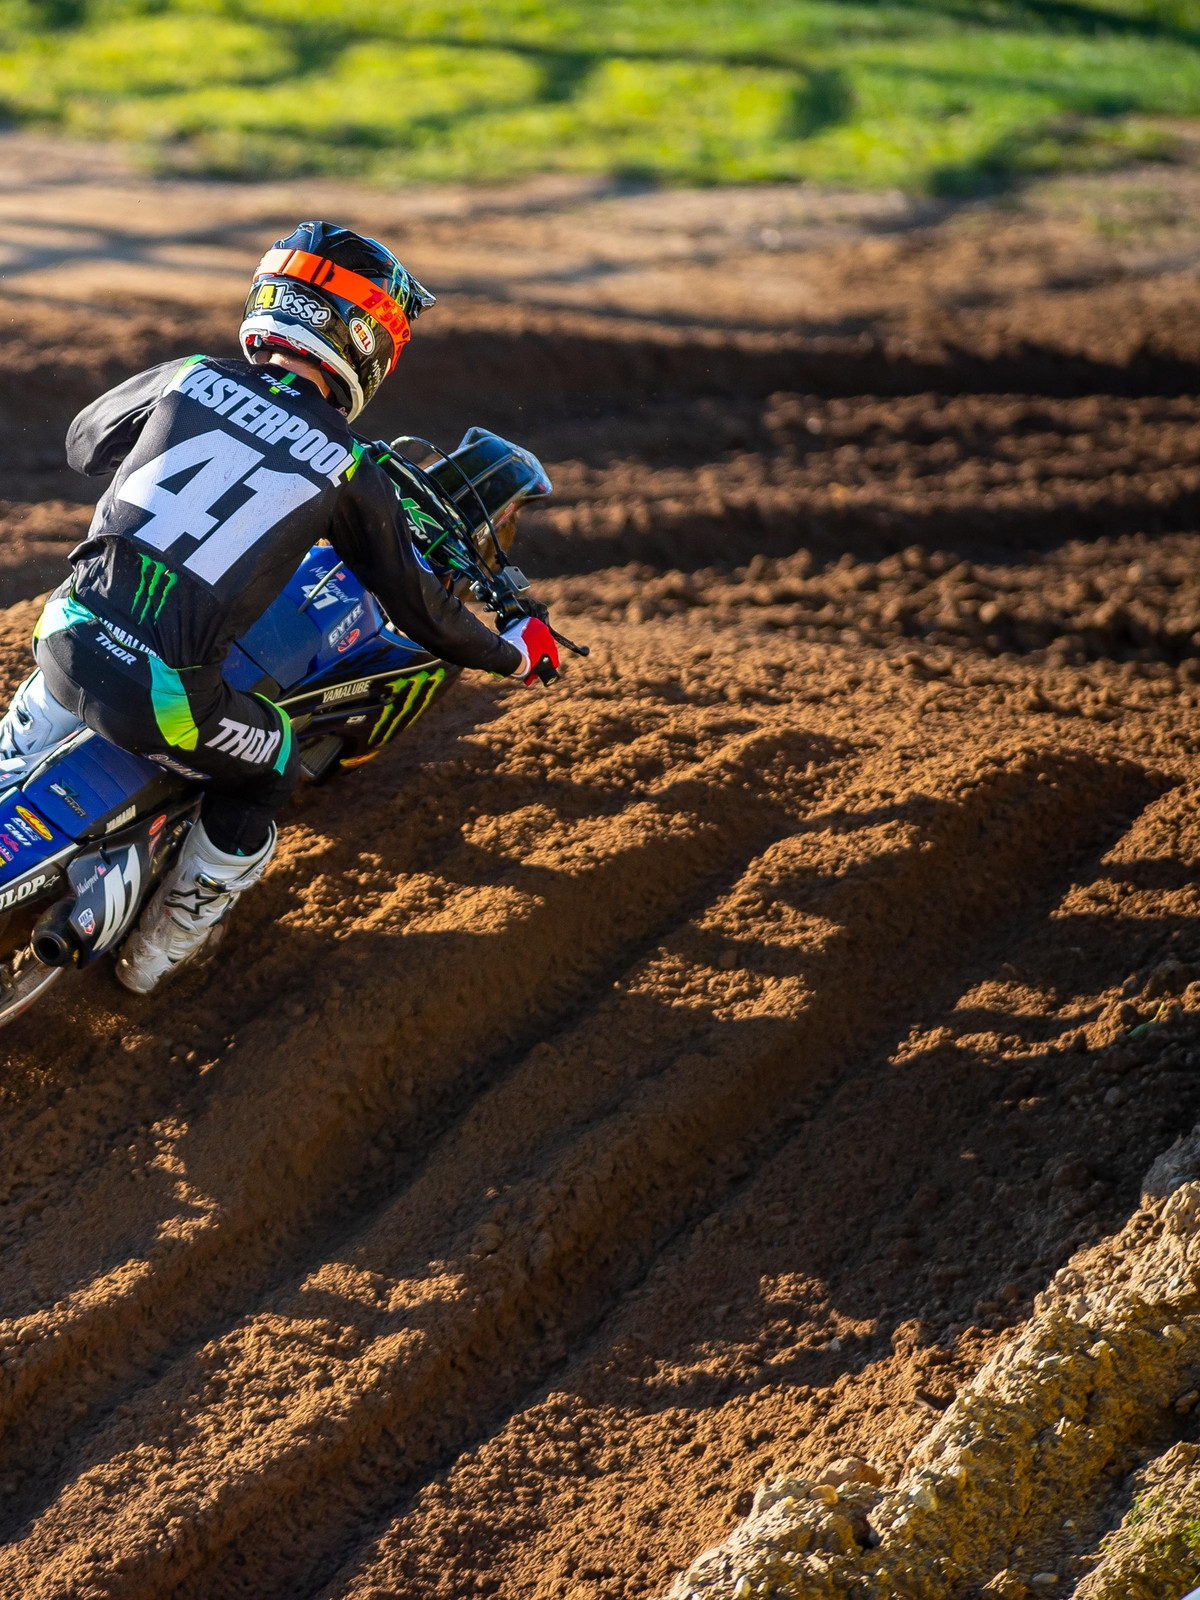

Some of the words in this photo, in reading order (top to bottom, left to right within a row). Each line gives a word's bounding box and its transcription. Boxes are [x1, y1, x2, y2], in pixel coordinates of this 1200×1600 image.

[353, 322, 373, 352] BELL
[260, 373, 301, 397] THOR
[116, 428, 322, 587] 41
[300, 584, 339, 610] 41
[328, 602, 363, 646] GYTR
[95, 631, 137, 666] THOR
[322, 680, 371, 703] YAMALUBE
[204, 717, 281, 764] THOR
